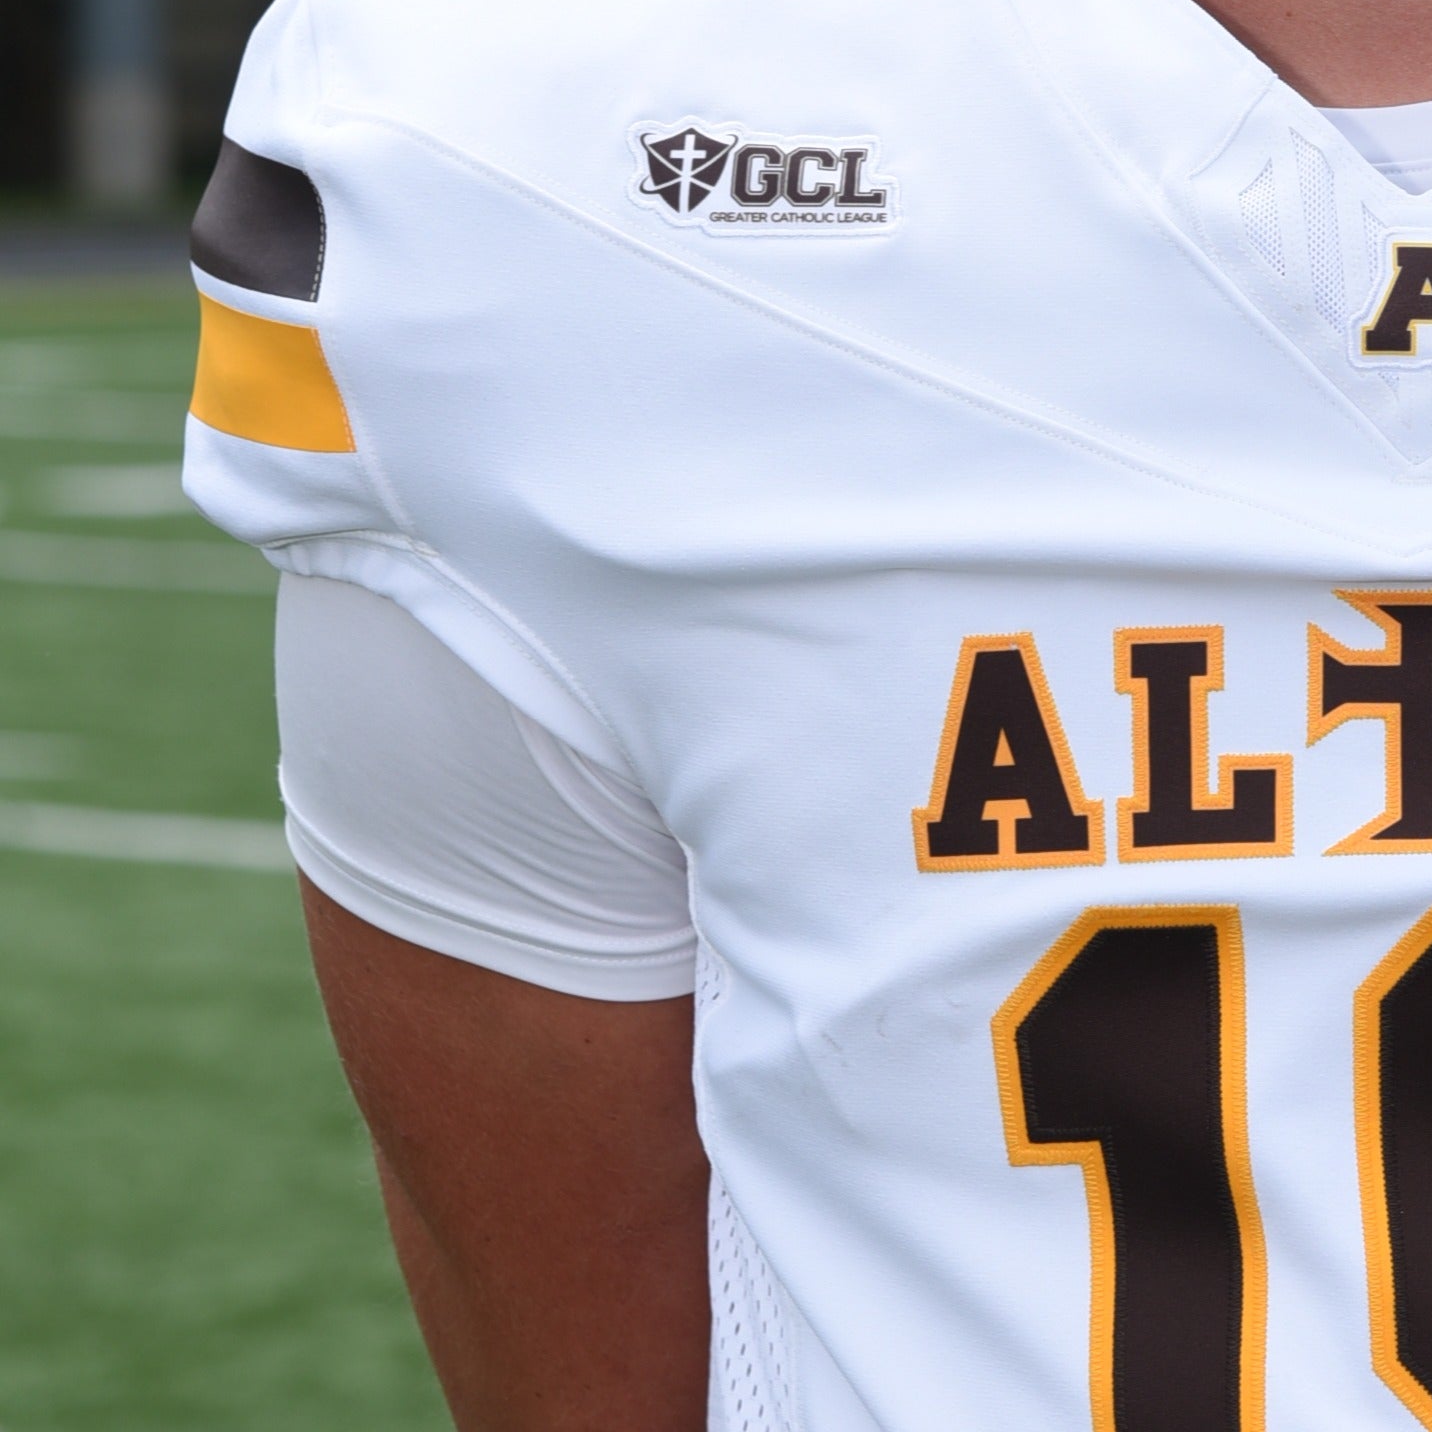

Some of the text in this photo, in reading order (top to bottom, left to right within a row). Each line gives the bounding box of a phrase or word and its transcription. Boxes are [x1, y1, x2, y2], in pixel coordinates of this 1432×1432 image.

[731, 144, 886, 207] GCL
[709, 211, 888, 223] GREATER CATHOLIC LEAGUE
